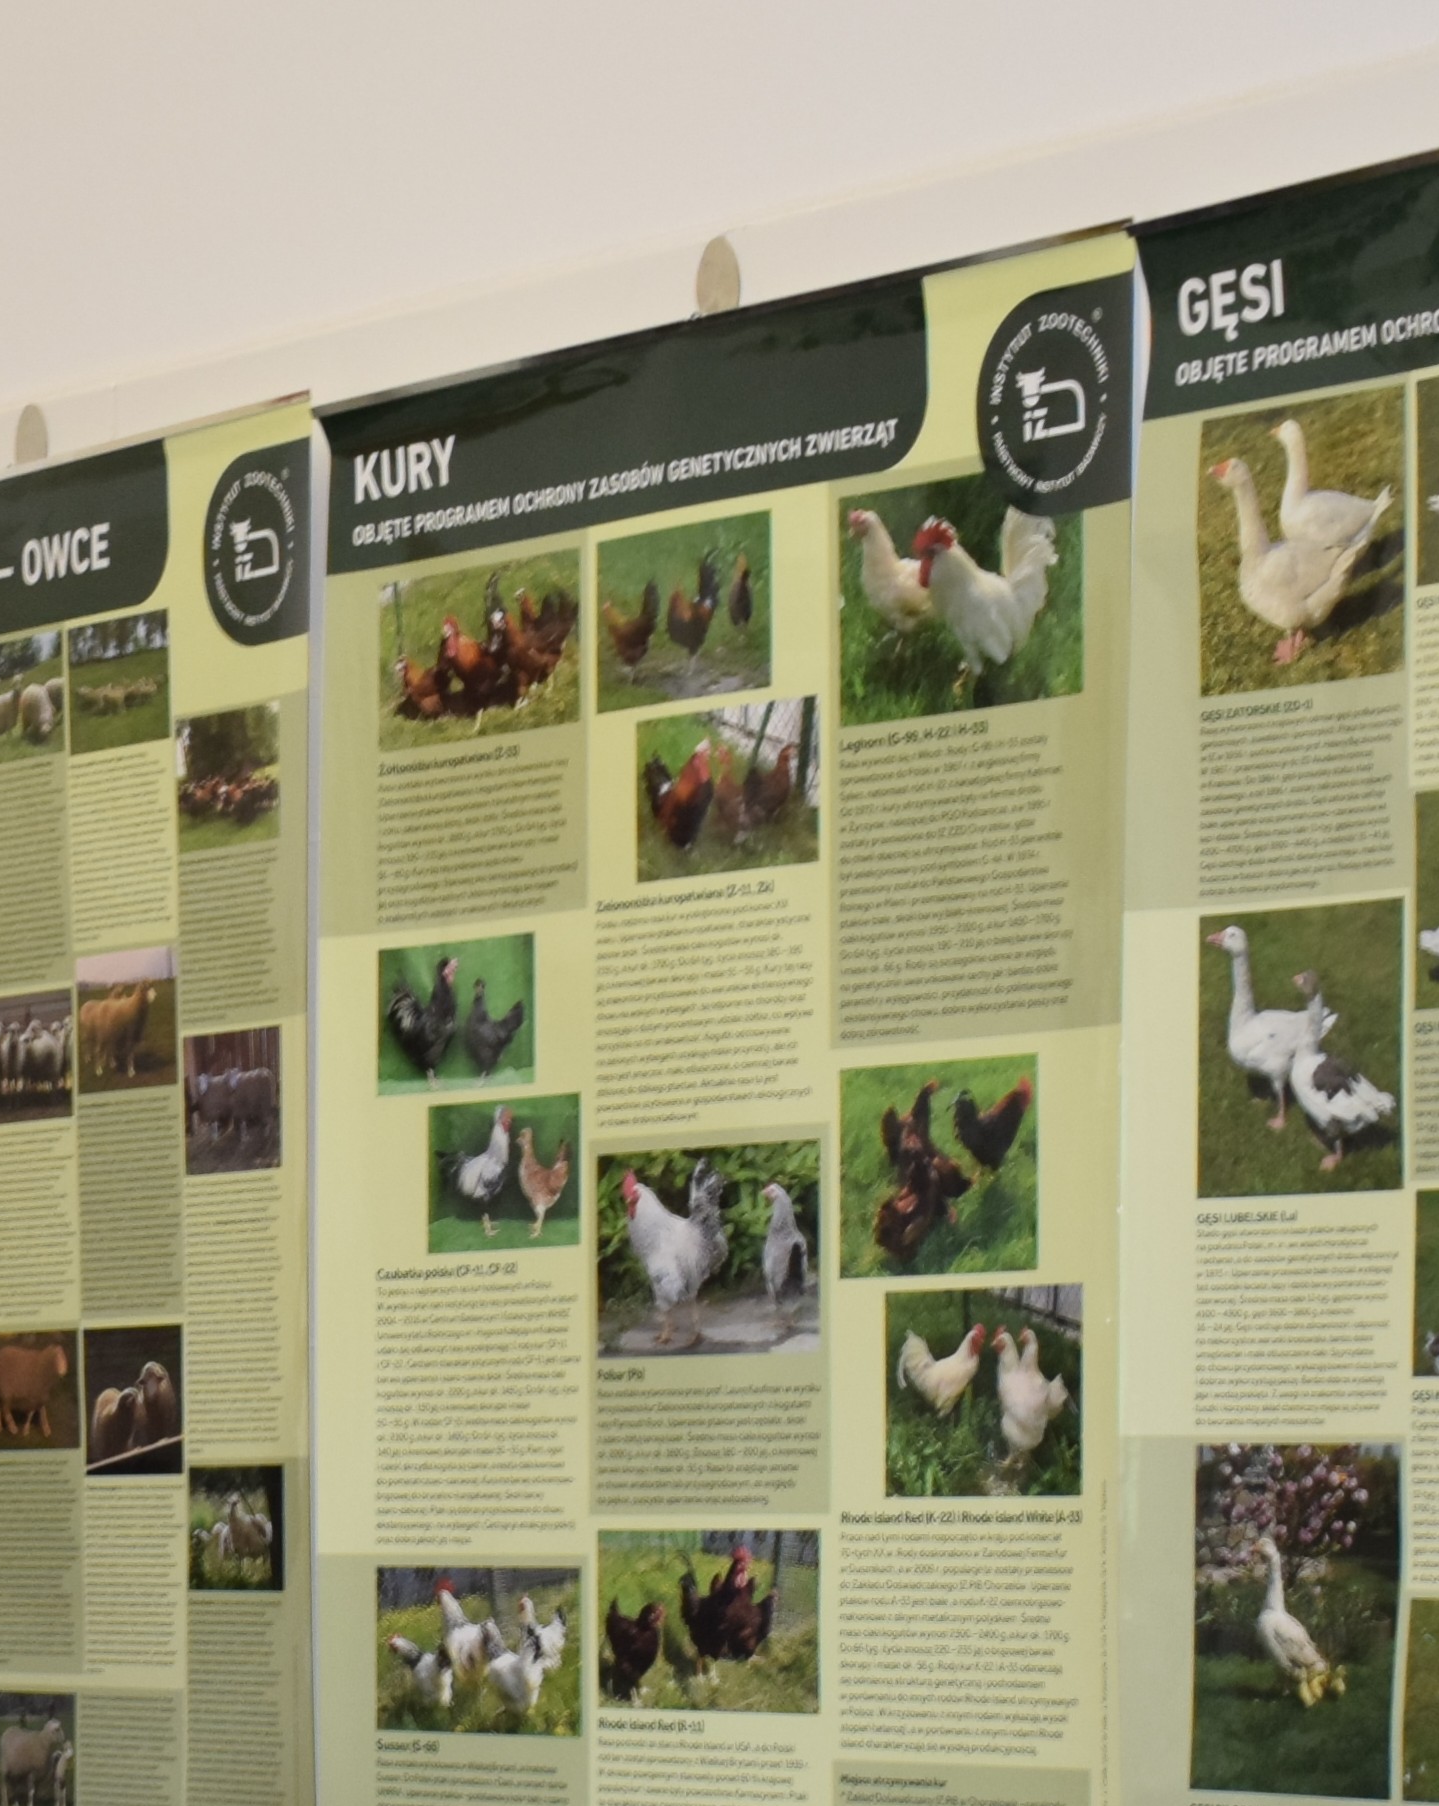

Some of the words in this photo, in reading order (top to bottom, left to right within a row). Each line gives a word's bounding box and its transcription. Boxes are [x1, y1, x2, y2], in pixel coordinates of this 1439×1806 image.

[1176, 259, 1284, 347] GĘSI
[1037, 312, 1109, 384] ZOOTECHNIKI
[1174, 348, 1248, 387] OBJĘTE
[1252, 322, 1376, 371] PROGRAMEM
[352, 514, 412, 547] OBJĘTE
[414, 494, 510, 535] PROGRAMEM
[512, 479, 586, 515] OCHRONY
[588, 459, 664, 501] ZASOBÓW
[666, 437, 800, 485] GENETYCZNYCH
[804, 418, 898, 458] ZWIERZĄT
[354, 435, 456, 504] KURY
[20, 523, 110, 587] OWCE
